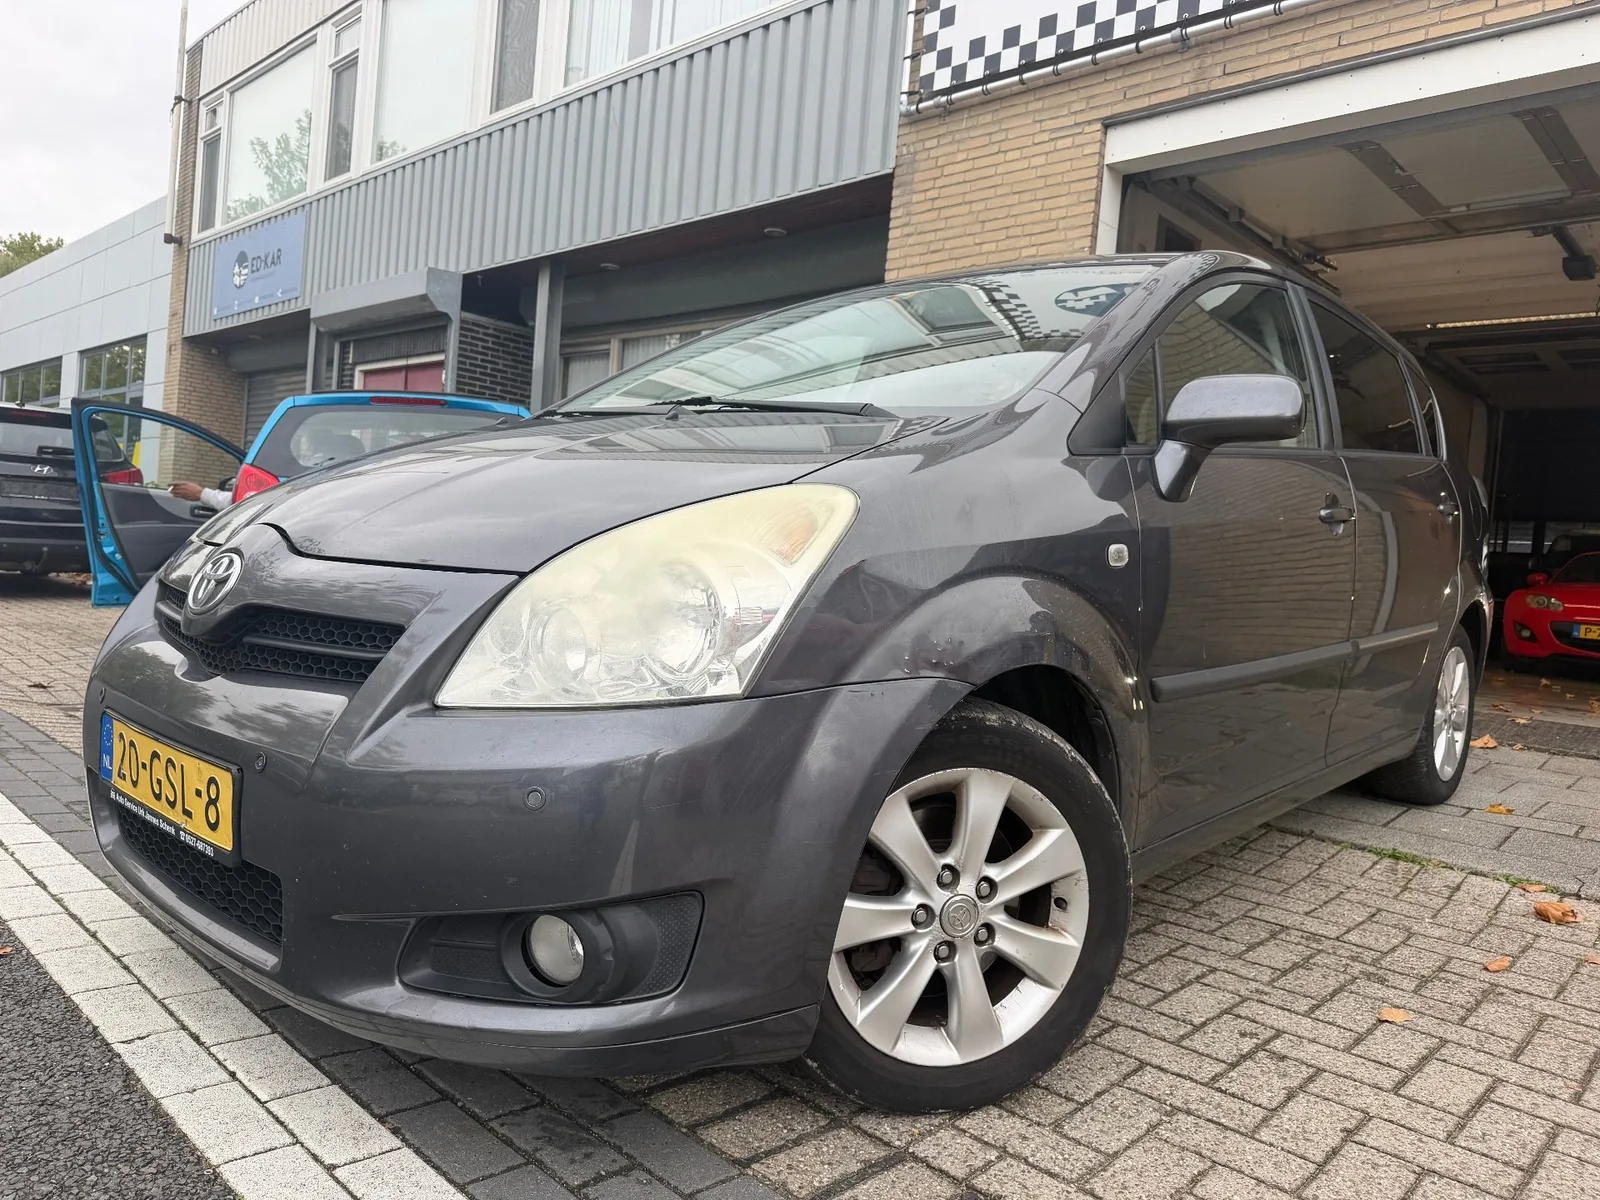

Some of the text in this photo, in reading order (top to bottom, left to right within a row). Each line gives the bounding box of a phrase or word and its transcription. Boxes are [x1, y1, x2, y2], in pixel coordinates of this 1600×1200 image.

[103, 753, 112, 770] NL
[117, 731, 220, 832] 20-GSL-8
[116, 792, 125, 805] Auto
